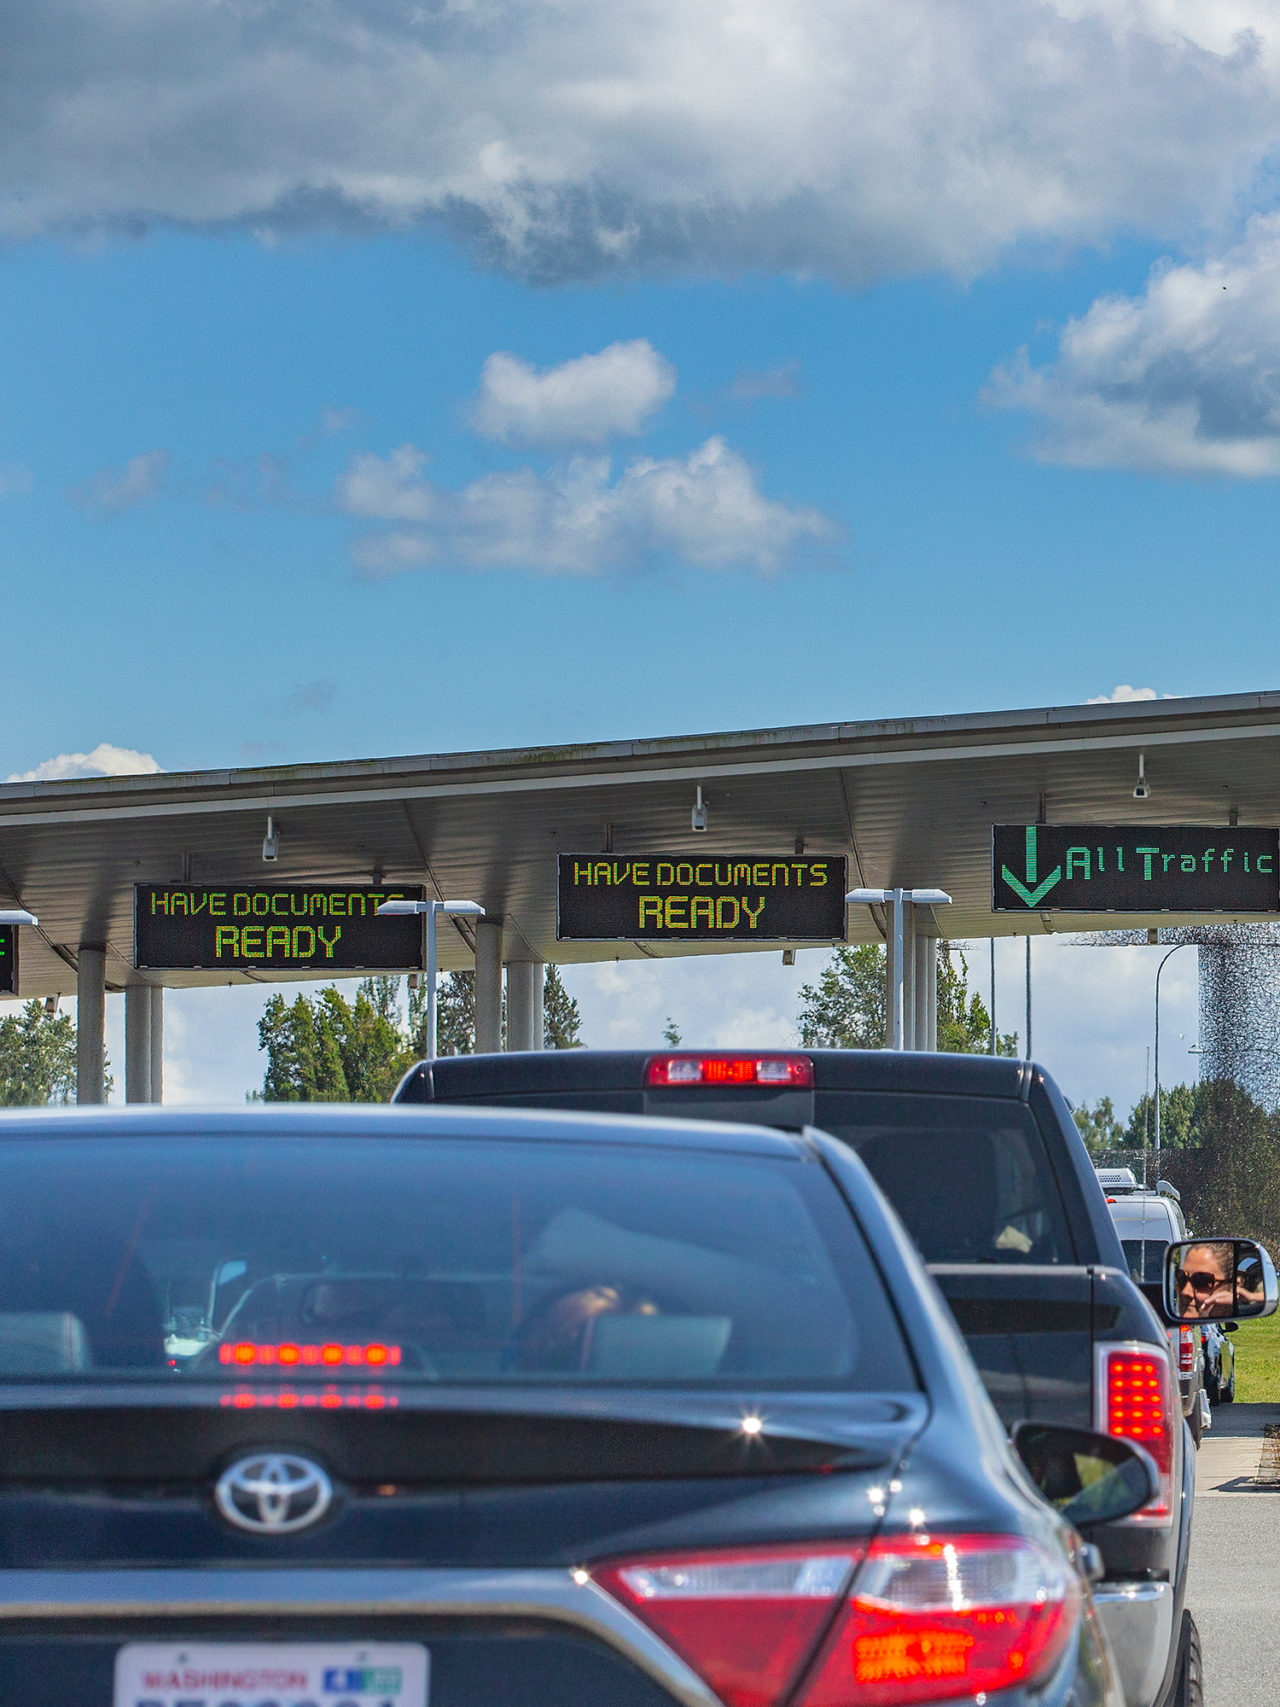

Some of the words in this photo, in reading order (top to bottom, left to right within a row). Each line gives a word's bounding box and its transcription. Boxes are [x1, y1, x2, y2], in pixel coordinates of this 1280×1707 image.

[574, 862, 650, 886] HAVE
[657, 863, 828, 887] DOCUMENTS
[1066, 846, 1125, 880] All
[1136, 847, 1273, 881] Traffic
[151, 892, 227, 916] HAVE
[638, 896, 766, 929] READY
[215, 925, 342, 958] READY
